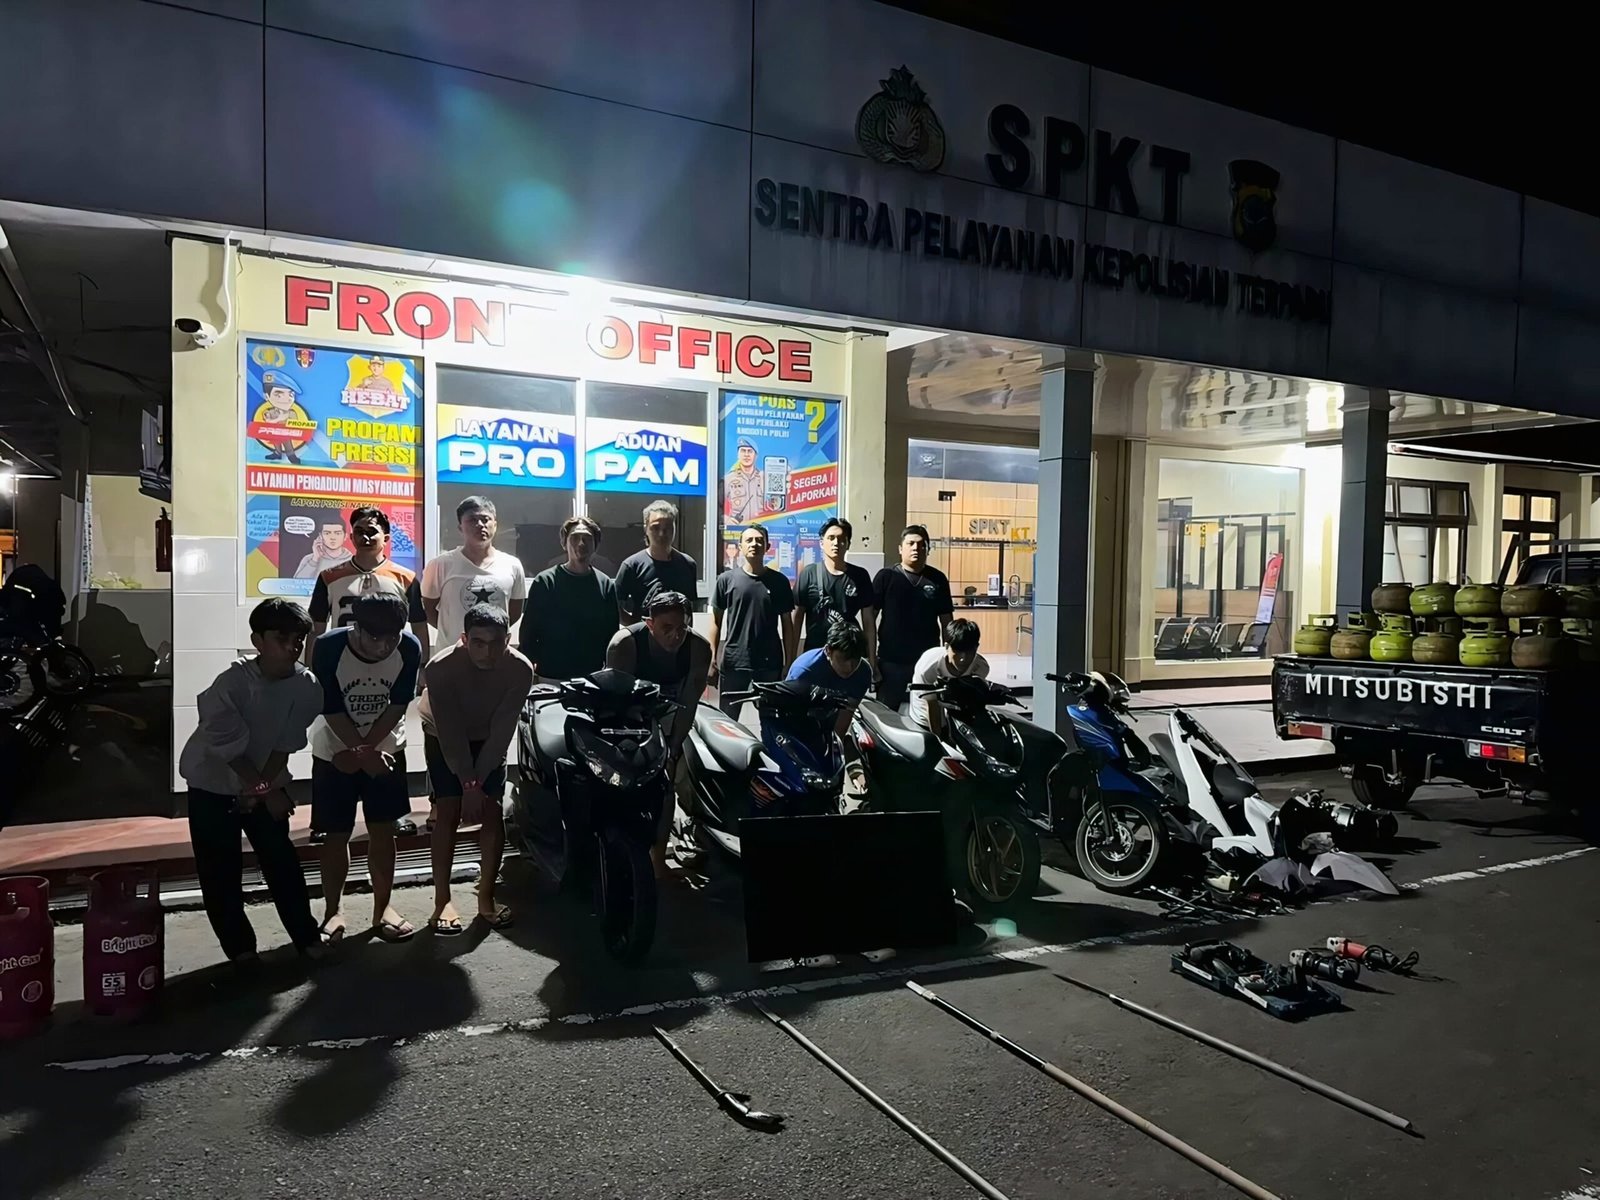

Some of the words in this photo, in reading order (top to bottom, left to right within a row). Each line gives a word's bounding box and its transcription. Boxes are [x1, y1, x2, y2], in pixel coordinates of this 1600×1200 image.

[985, 104, 1190, 226] SPKT
[755, 178, 894, 248] SENTRA
[904, 208, 1075, 280] PELAYANAN
[285, 275, 556, 346] FRON
[586, 315, 812, 382] OFFICE
[341, 389, 410, 410] HEBAT
[759, 394, 797, 410] PUAS
[287, 420, 316, 428] PROPAM
[765, 410, 804, 421] PELAYANAN
[805, 400, 826, 443] ?
[326, 418, 422, 444] PROPAM
[455, 418, 559, 444] LAYANAN
[615, 432, 681, 453] ADUAN
[331, 441, 416, 465] PRESISI
[448, 441, 566, 478] PRO
[595, 453, 699, 486] PAM
[251, 472, 295, 489] LAYANAN
[297, 475, 351, 493] PENGADUAN
[353, 479, 415, 496] MASYARAKAT
[794, 475, 828, 489] SEGERA
[790, 486, 837, 504] LAPORKAN
[969, 519, 1010, 535] SPKT
[349, 693, 389, 702] GREEN
[1305, 673, 1492, 709] MITSUBISHI
[351, 701, 386, 712] LIGHT
[1481, 725, 1526, 736] COLT
